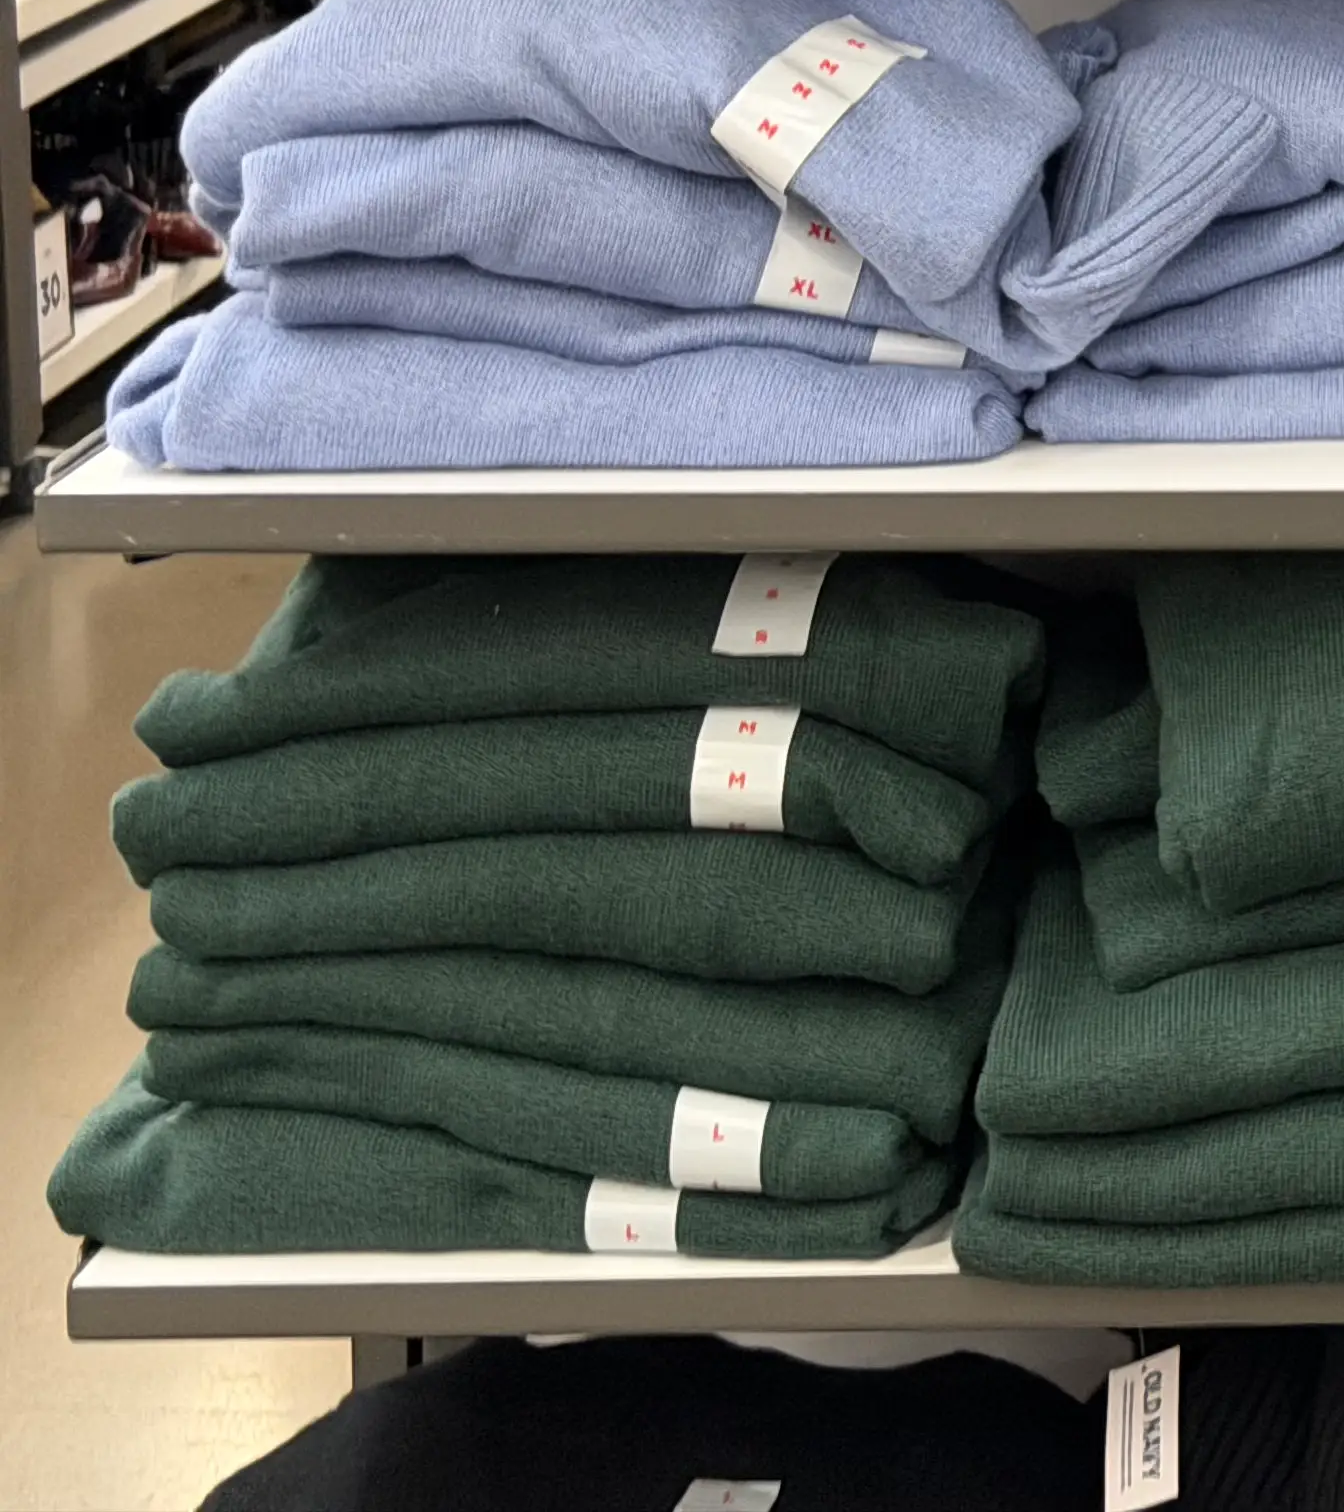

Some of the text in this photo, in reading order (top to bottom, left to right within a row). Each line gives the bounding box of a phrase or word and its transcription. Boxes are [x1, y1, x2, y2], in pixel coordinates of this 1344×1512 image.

[819, 58, 840, 76] M
[792, 81, 813, 100] M
[757, 117, 780, 141] M
[808, 219, 837, 246] XL
[41, 270, 62, 318] 30
[790, 275, 819, 301] XL
[738, 719, 757, 736] M
[728, 770, 747, 790] M
[713, 1123, 725, 1143] L
[625, 1222, 641, 1243] L
[1142, 1369, 1163, 1416] OLD
